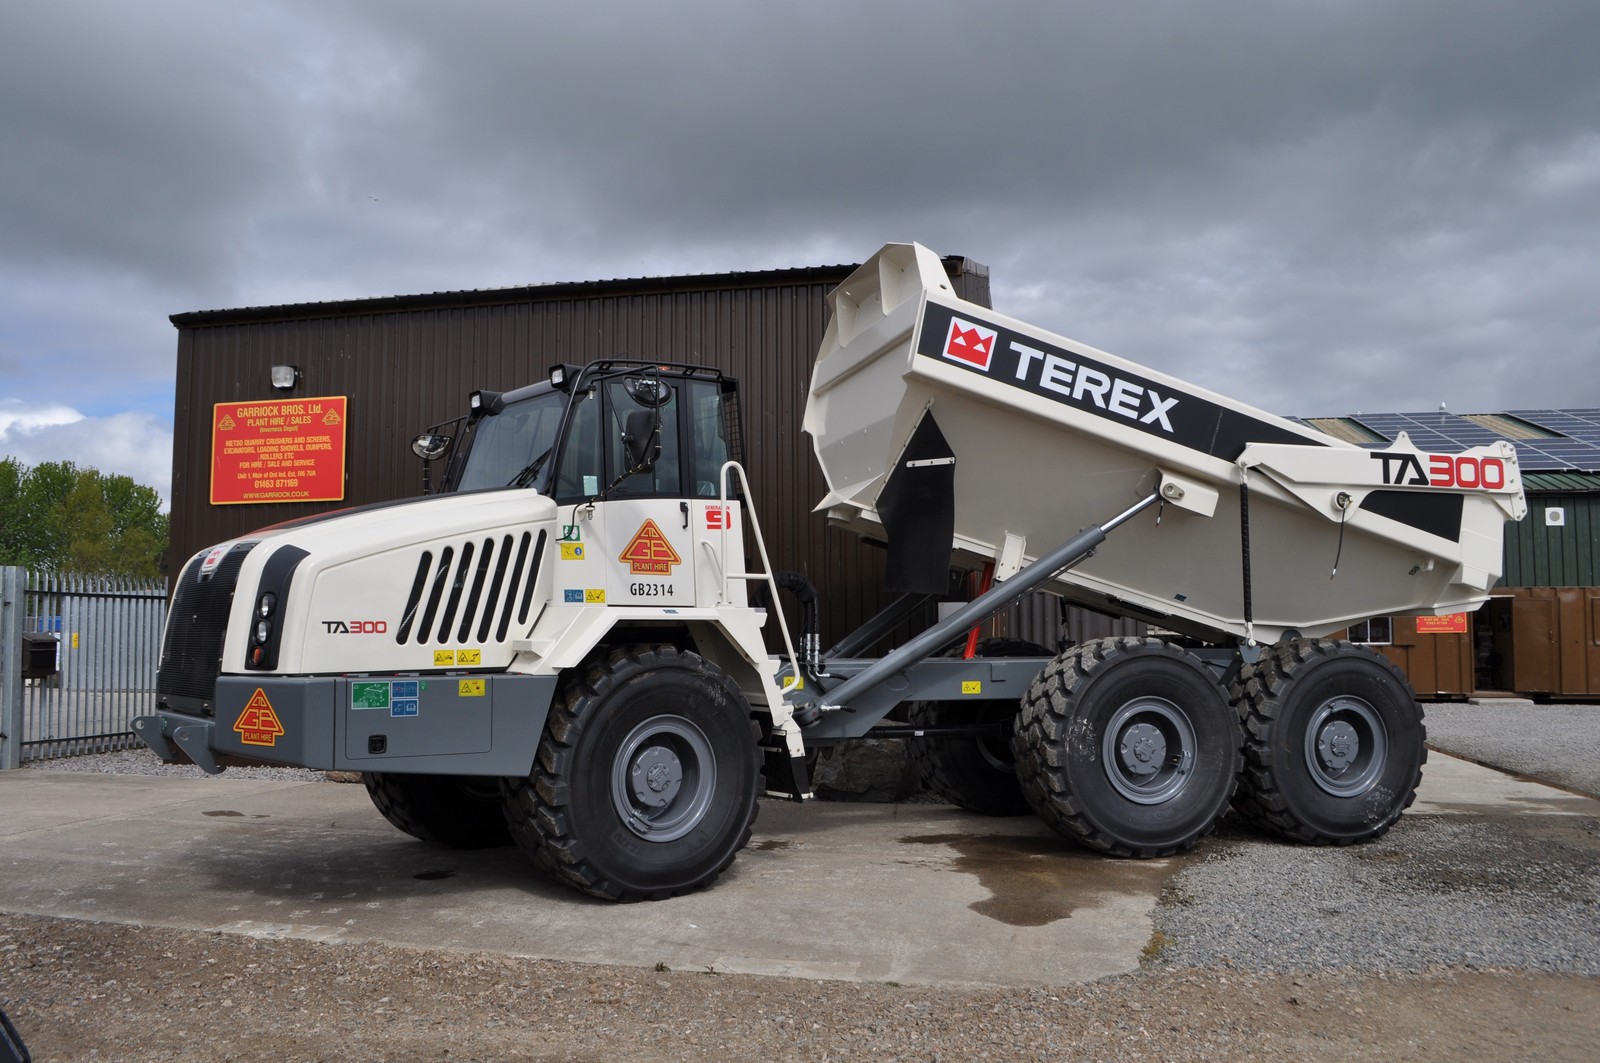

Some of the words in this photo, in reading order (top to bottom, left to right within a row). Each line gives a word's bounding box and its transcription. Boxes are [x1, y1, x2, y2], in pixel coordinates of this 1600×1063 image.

[1010, 341, 1180, 433] TEREX
[237, 406, 279, 417] GARRIOCK
[281, 405, 305, 415] BROS.
[309, 404, 323, 413] Ltd.
[248, 418, 268, 426] PLANT
[291, 416, 311, 424] SALES
[1370, 452, 1504, 489] TA300
[255, 479, 273, 488] 01463
[276, 479, 298, 487] 871169
[626, 539, 674, 560] GB
[654, 563, 667, 571] HIRE
[630, 583, 674, 596] GB2314
[322, 621, 387, 633] TA300
[239, 709, 279, 731] GB
